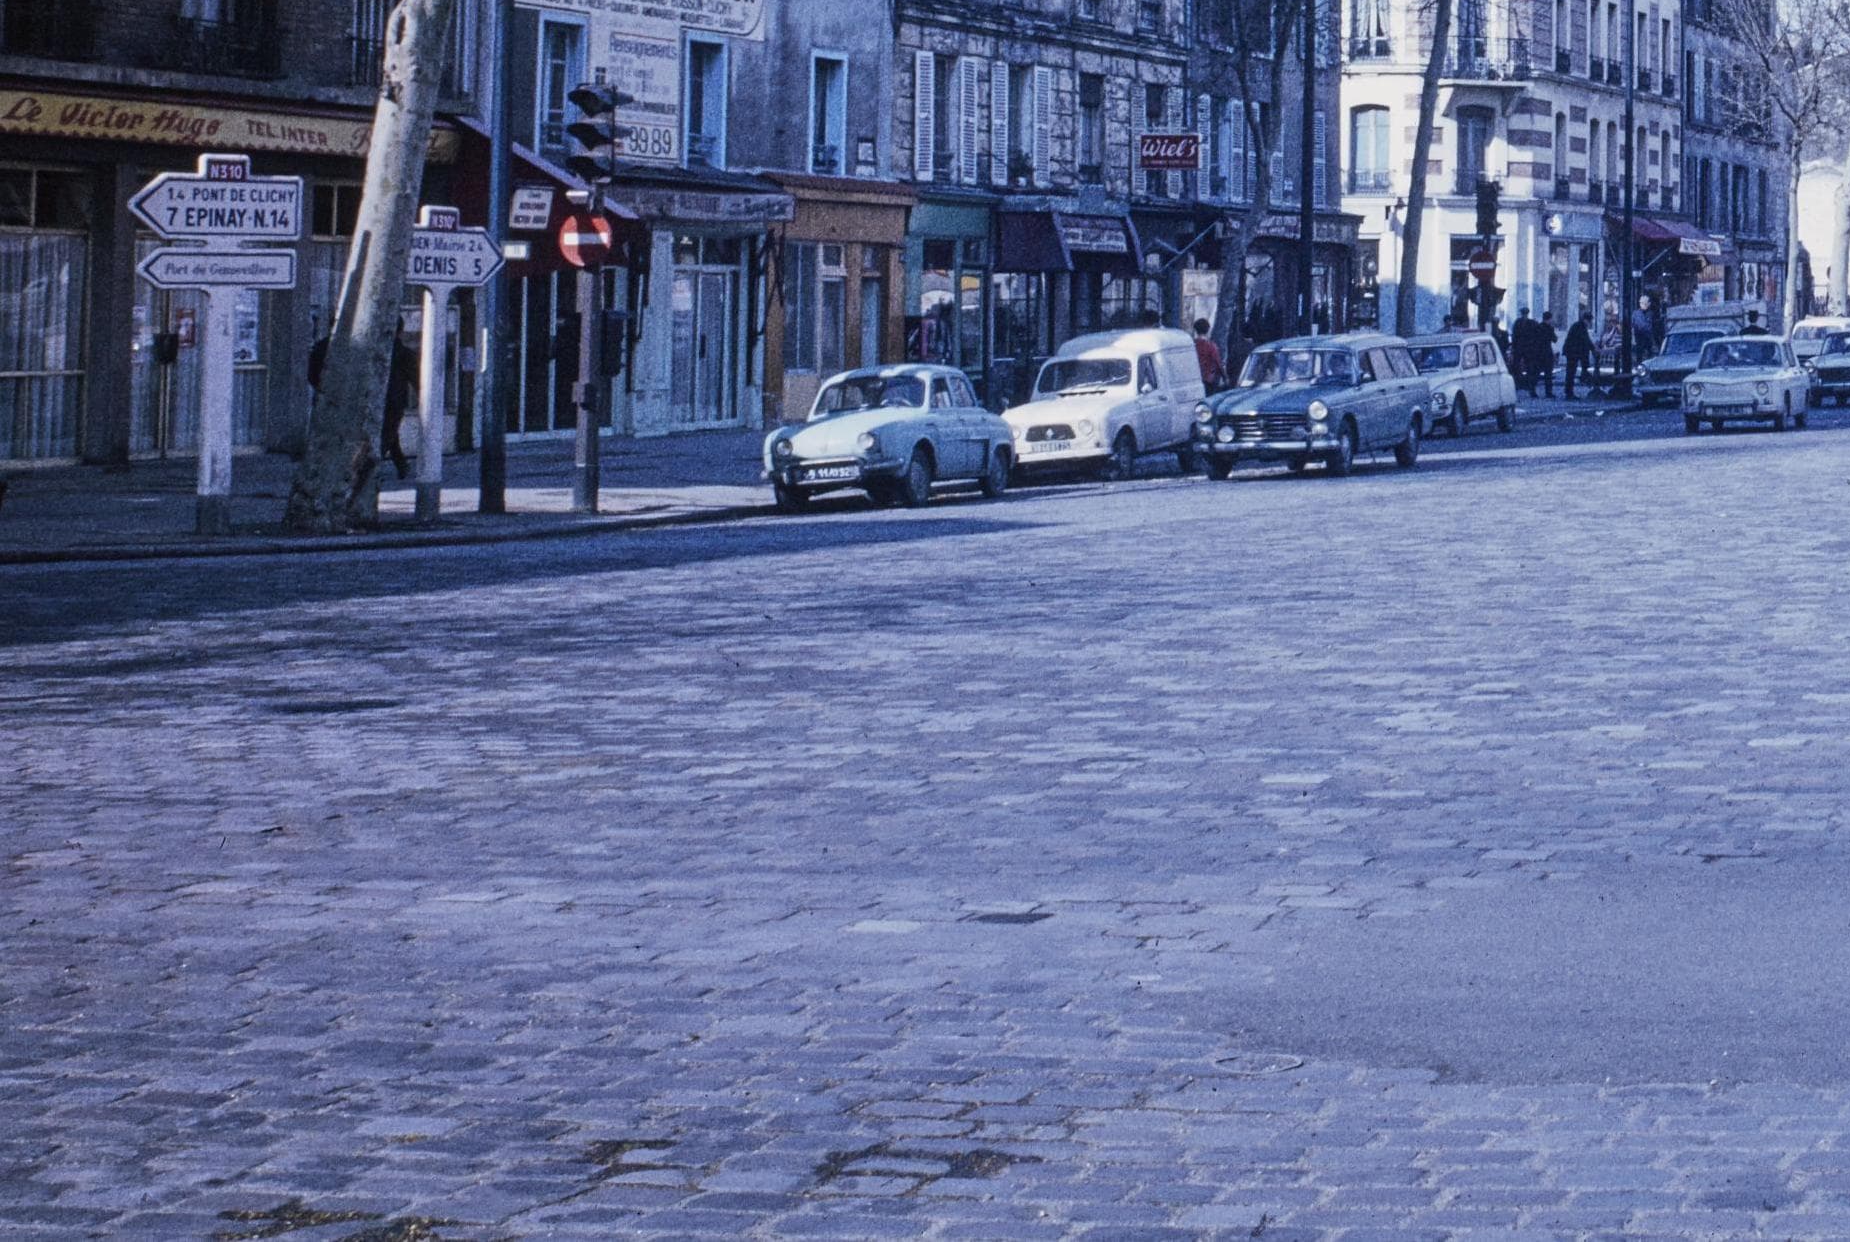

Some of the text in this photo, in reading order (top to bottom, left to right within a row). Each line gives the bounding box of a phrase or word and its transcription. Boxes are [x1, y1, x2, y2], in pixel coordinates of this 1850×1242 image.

[2, 97, 43, 123] Le
[59, 103, 145, 131] Victor
[151, 109, 224, 146] Hugo
[1142, 138, 1197, 158] Wiel's
[210, 163, 243, 180] N310
[192, 187, 226, 202] PONT
[230, 188, 246, 203] DE
[250, 188, 296, 204] CLICHY
[166, 206, 179, 227] 7
[163, 262, 188, 277] Port
[413, 255, 483, 277] DENIS 5
